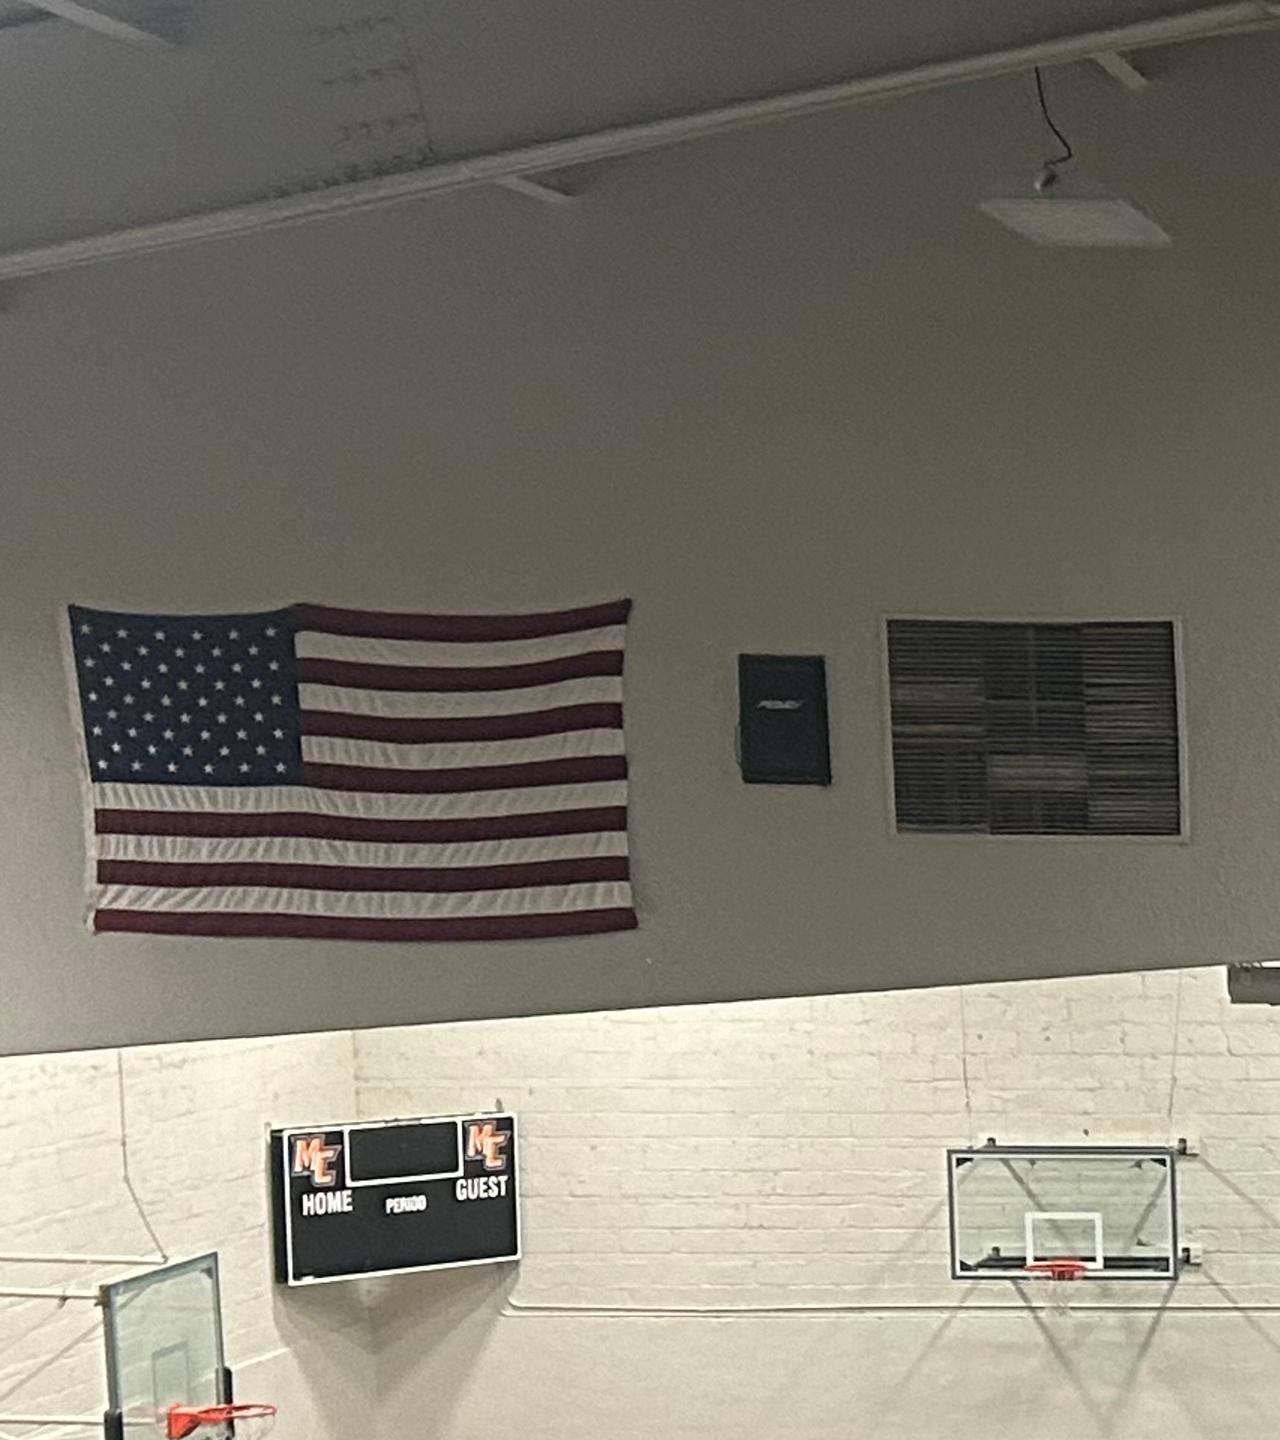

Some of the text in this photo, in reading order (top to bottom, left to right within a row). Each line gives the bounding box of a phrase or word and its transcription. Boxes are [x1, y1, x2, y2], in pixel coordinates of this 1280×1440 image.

[302, 1175, 509, 1216] HOME PERIOD GUEST
